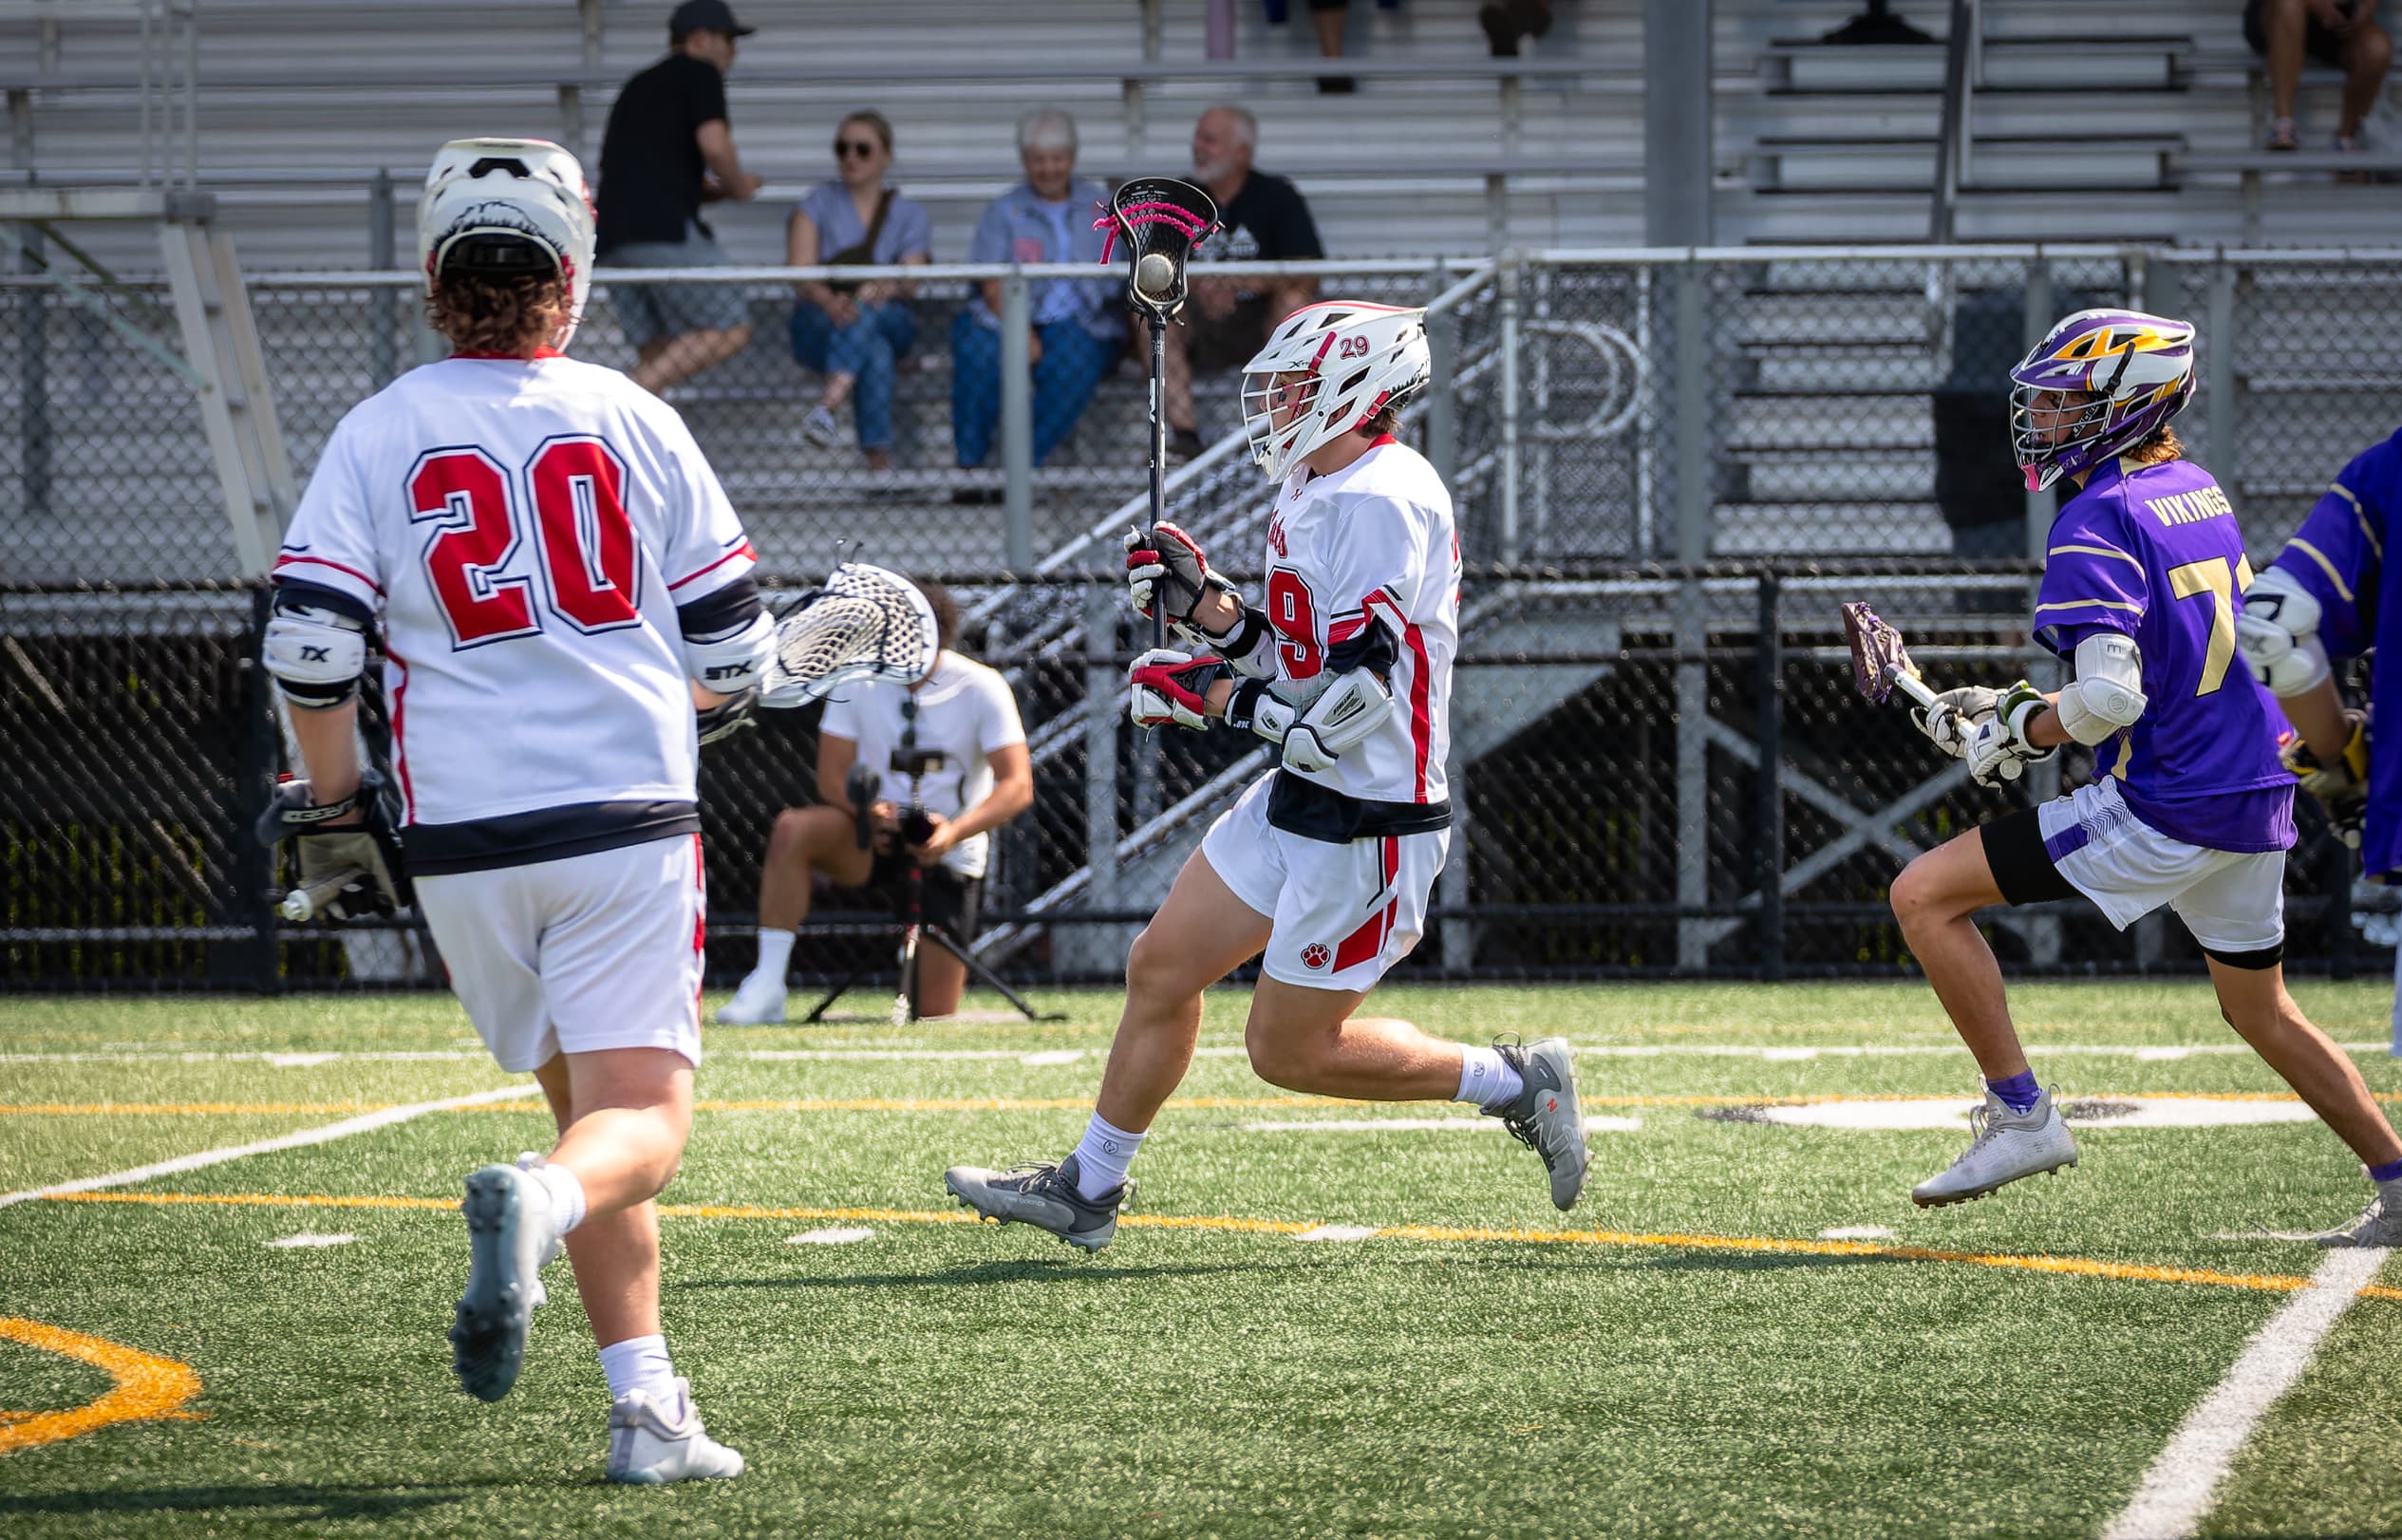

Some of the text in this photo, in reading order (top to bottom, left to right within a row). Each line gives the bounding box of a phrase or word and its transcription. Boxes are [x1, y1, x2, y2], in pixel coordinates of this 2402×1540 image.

[1340, 335, 1370, 360] 29
[2144, 485, 2233, 527] VIKINGS
[403, 433, 643, 652] 20
[2167, 553, 2254, 699] 7
[704, 660, 754, 680] STX
